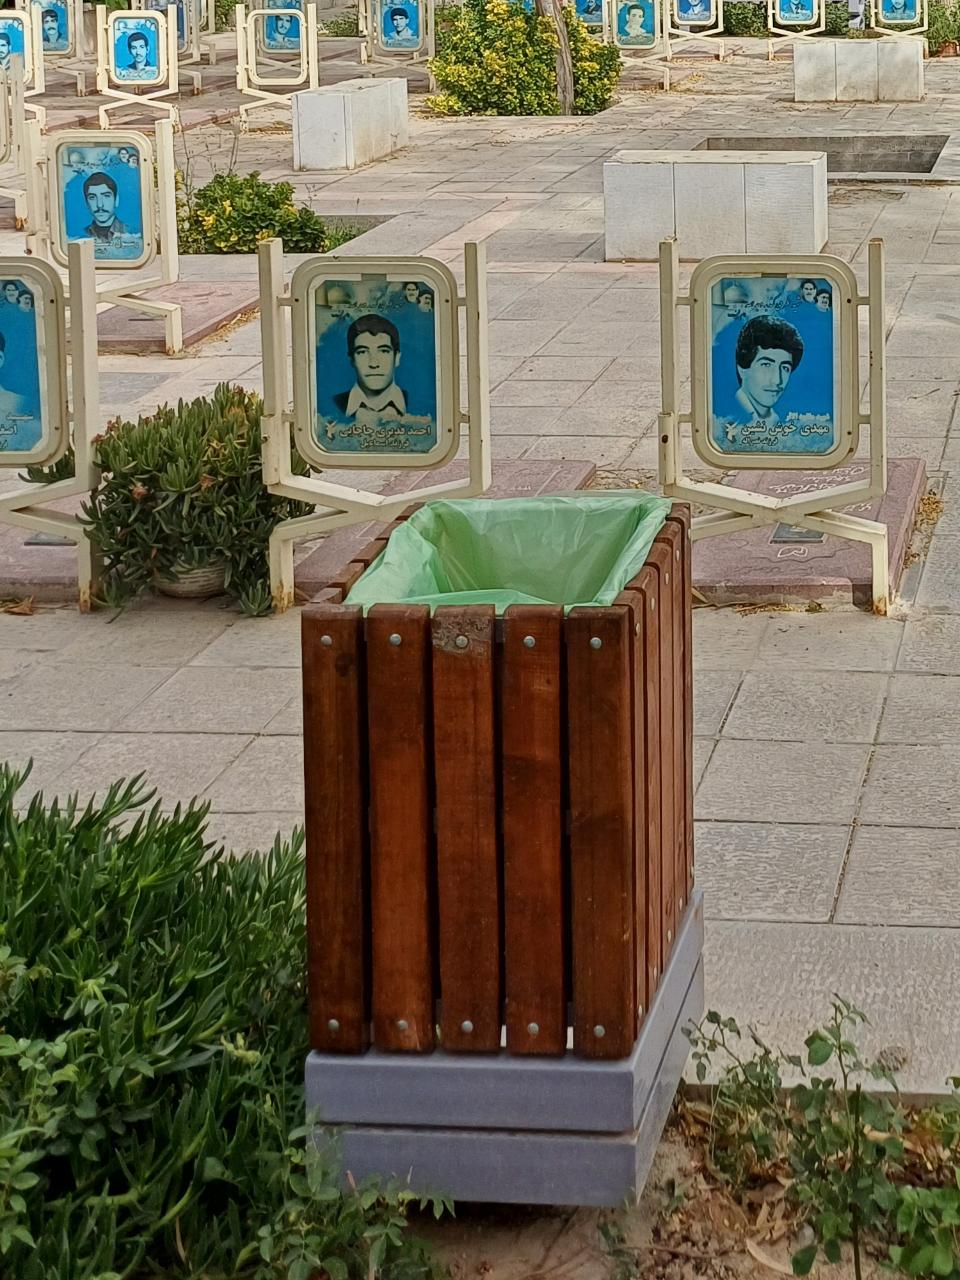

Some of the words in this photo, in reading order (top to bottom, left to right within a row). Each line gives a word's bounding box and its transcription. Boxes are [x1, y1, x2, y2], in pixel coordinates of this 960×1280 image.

[375, 425, 405, 439] قدیری
[407, 424, 432, 437] احمد
[740, 420, 768, 436] نشین
[768, 421, 798, 437] خوش
[800, 423, 830, 437] مهدی
[359, 438, 388, 449] اسماعیل
[389, 438, 410, 449] فرزند
[760, 436, 779, 447] فرزند
